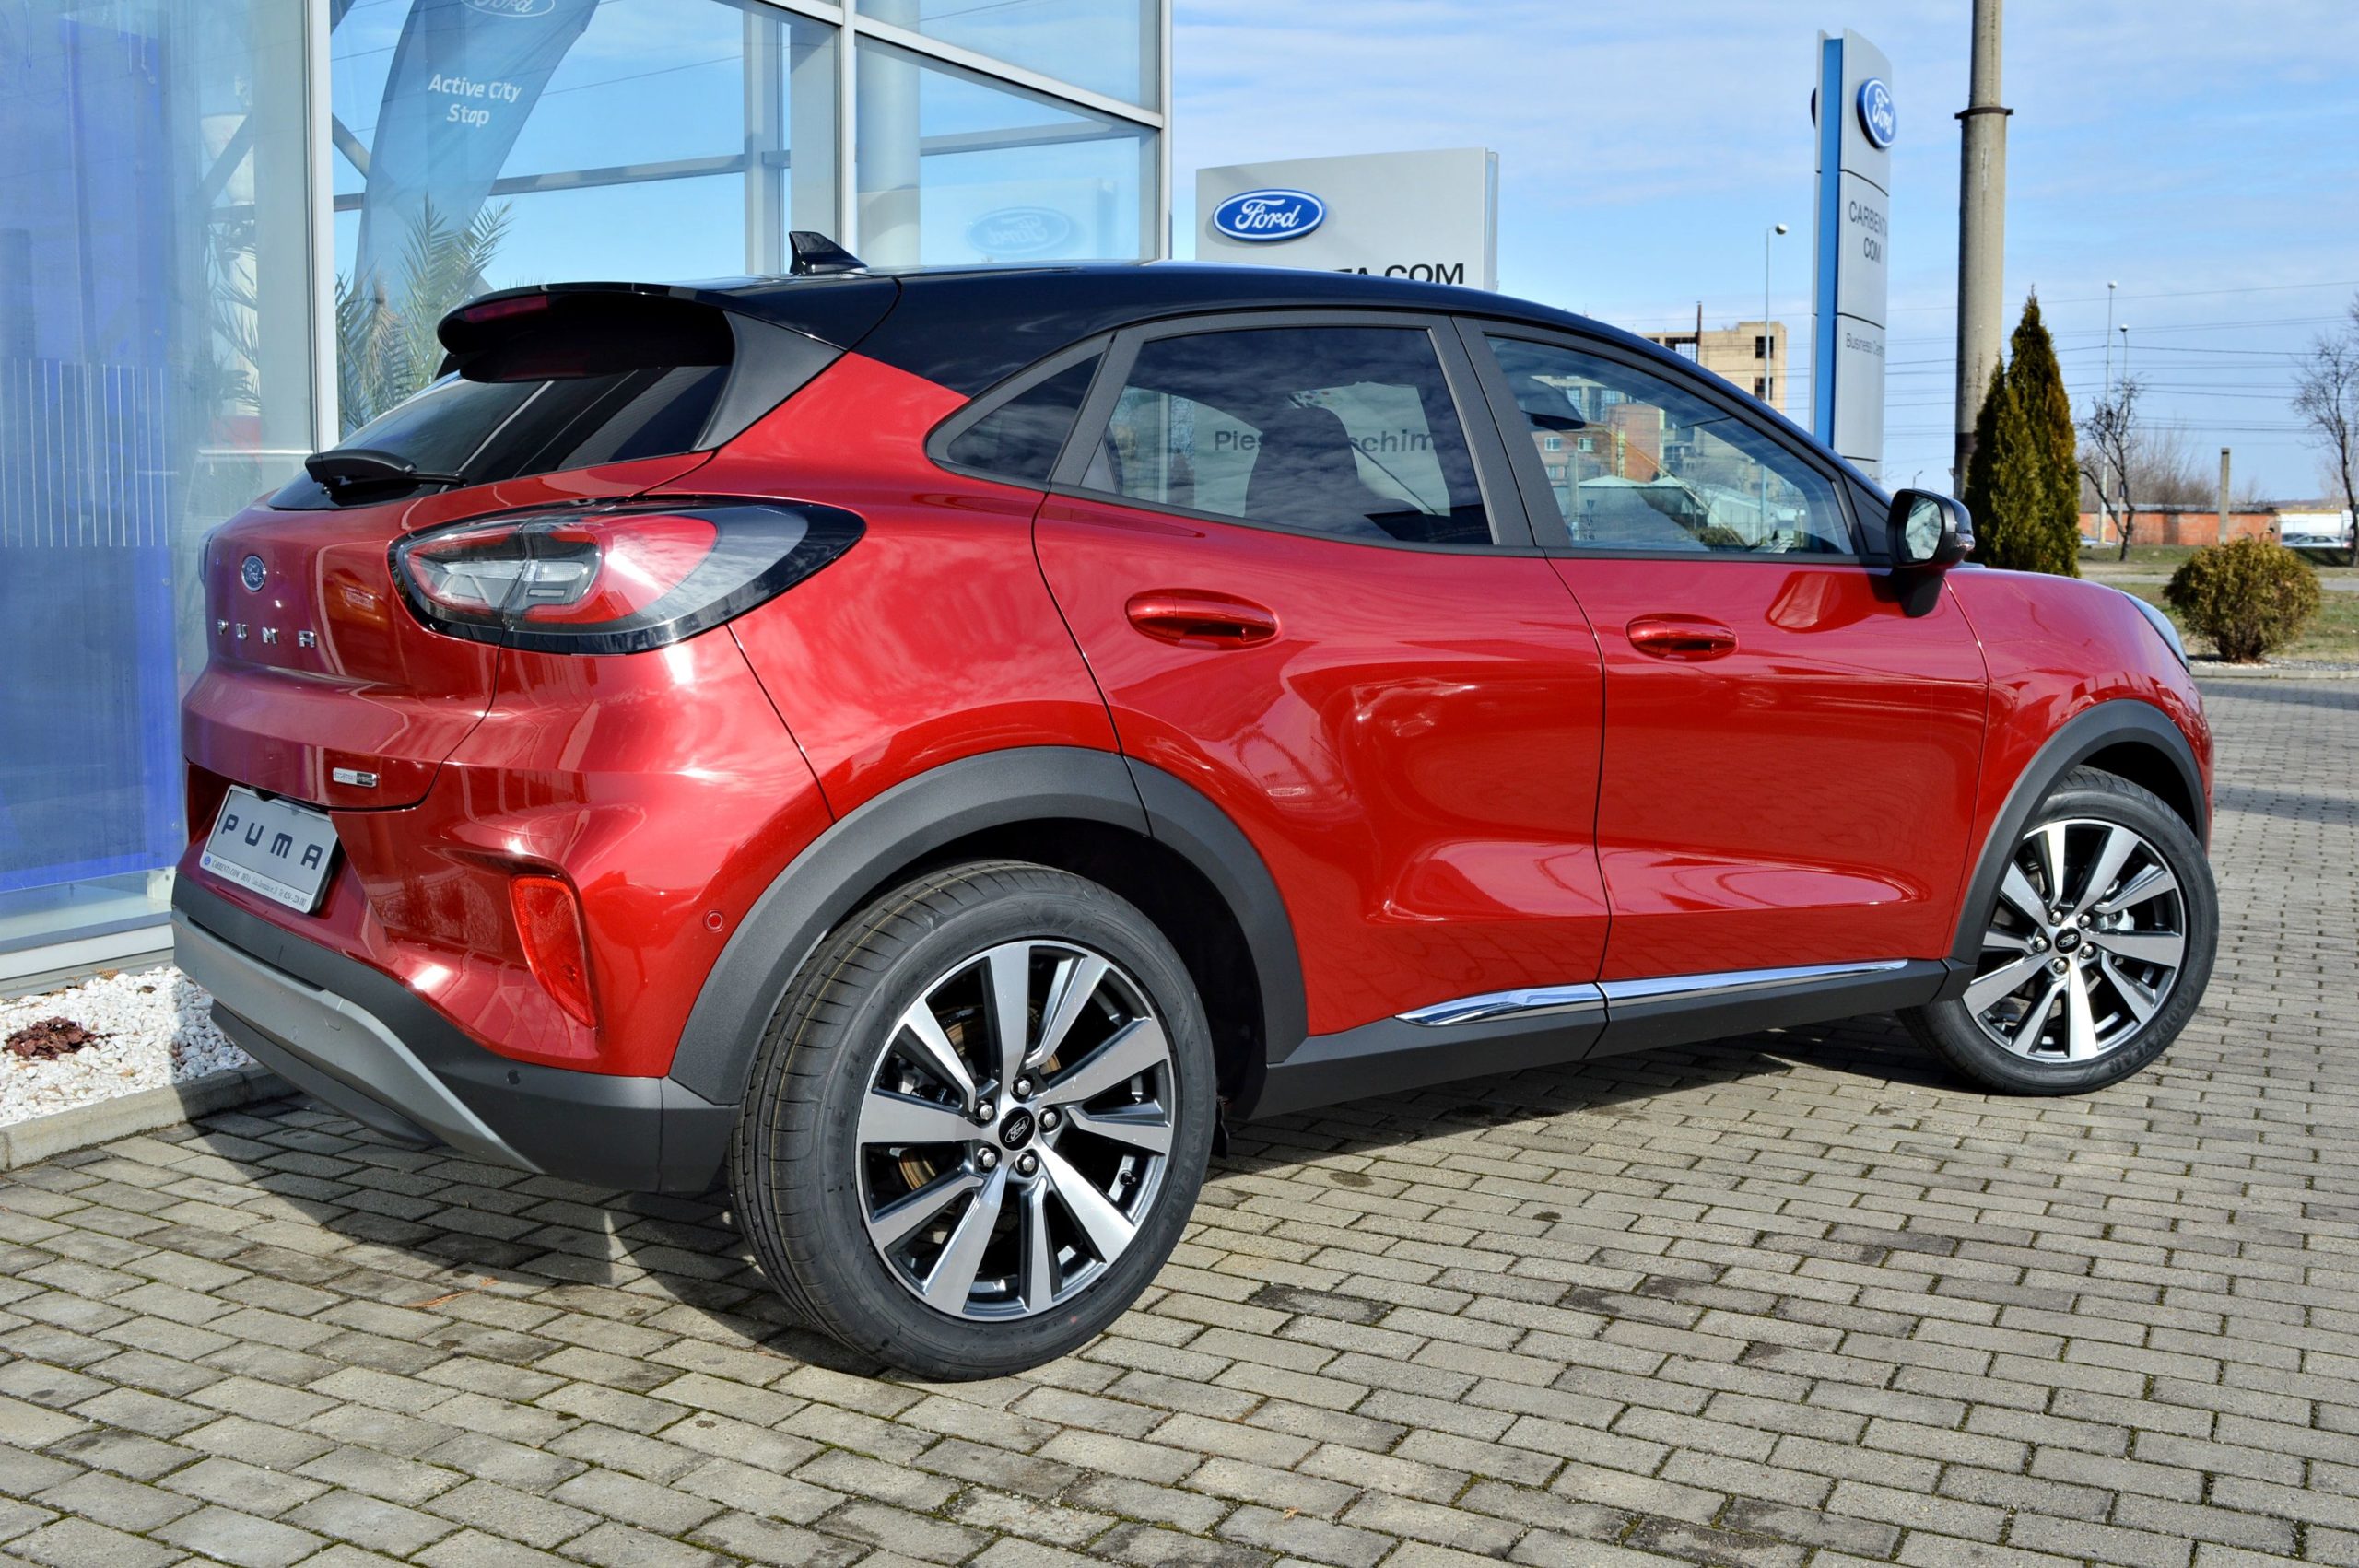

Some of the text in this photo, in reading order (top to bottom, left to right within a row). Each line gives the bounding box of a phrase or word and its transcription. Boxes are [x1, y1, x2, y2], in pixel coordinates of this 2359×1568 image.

[428, 74, 522, 103] Active City
[446, 103, 490, 128] Stop
[1872, 88, 1894, 135] Ford
[1235, 198, 1301, 229] Ford
[1864, 237, 1882, 263] COM
[1384, 263, 1463, 285] COM
[221, 813, 323, 870] PUMA
